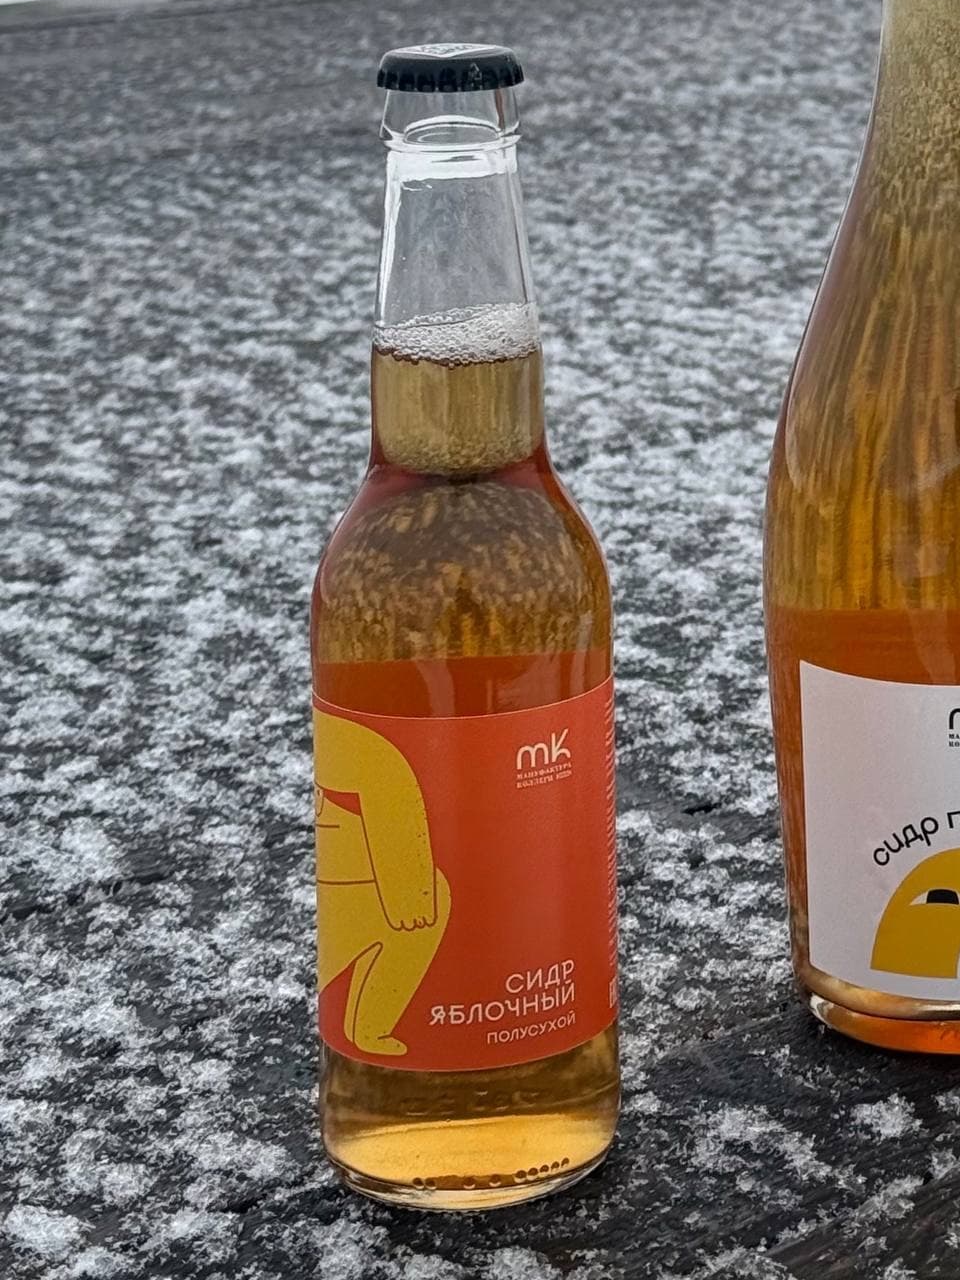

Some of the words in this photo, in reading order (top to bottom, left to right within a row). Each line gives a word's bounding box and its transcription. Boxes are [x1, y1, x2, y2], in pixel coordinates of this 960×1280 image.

[873, 817, 939, 866] сидр
[505, 959, 575, 994] СИДР
[429, 979, 575, 1026] ЯБЛОЧНЫЙ
[487, 1010, 576, 1045] ПОЛУСУХОЙ
